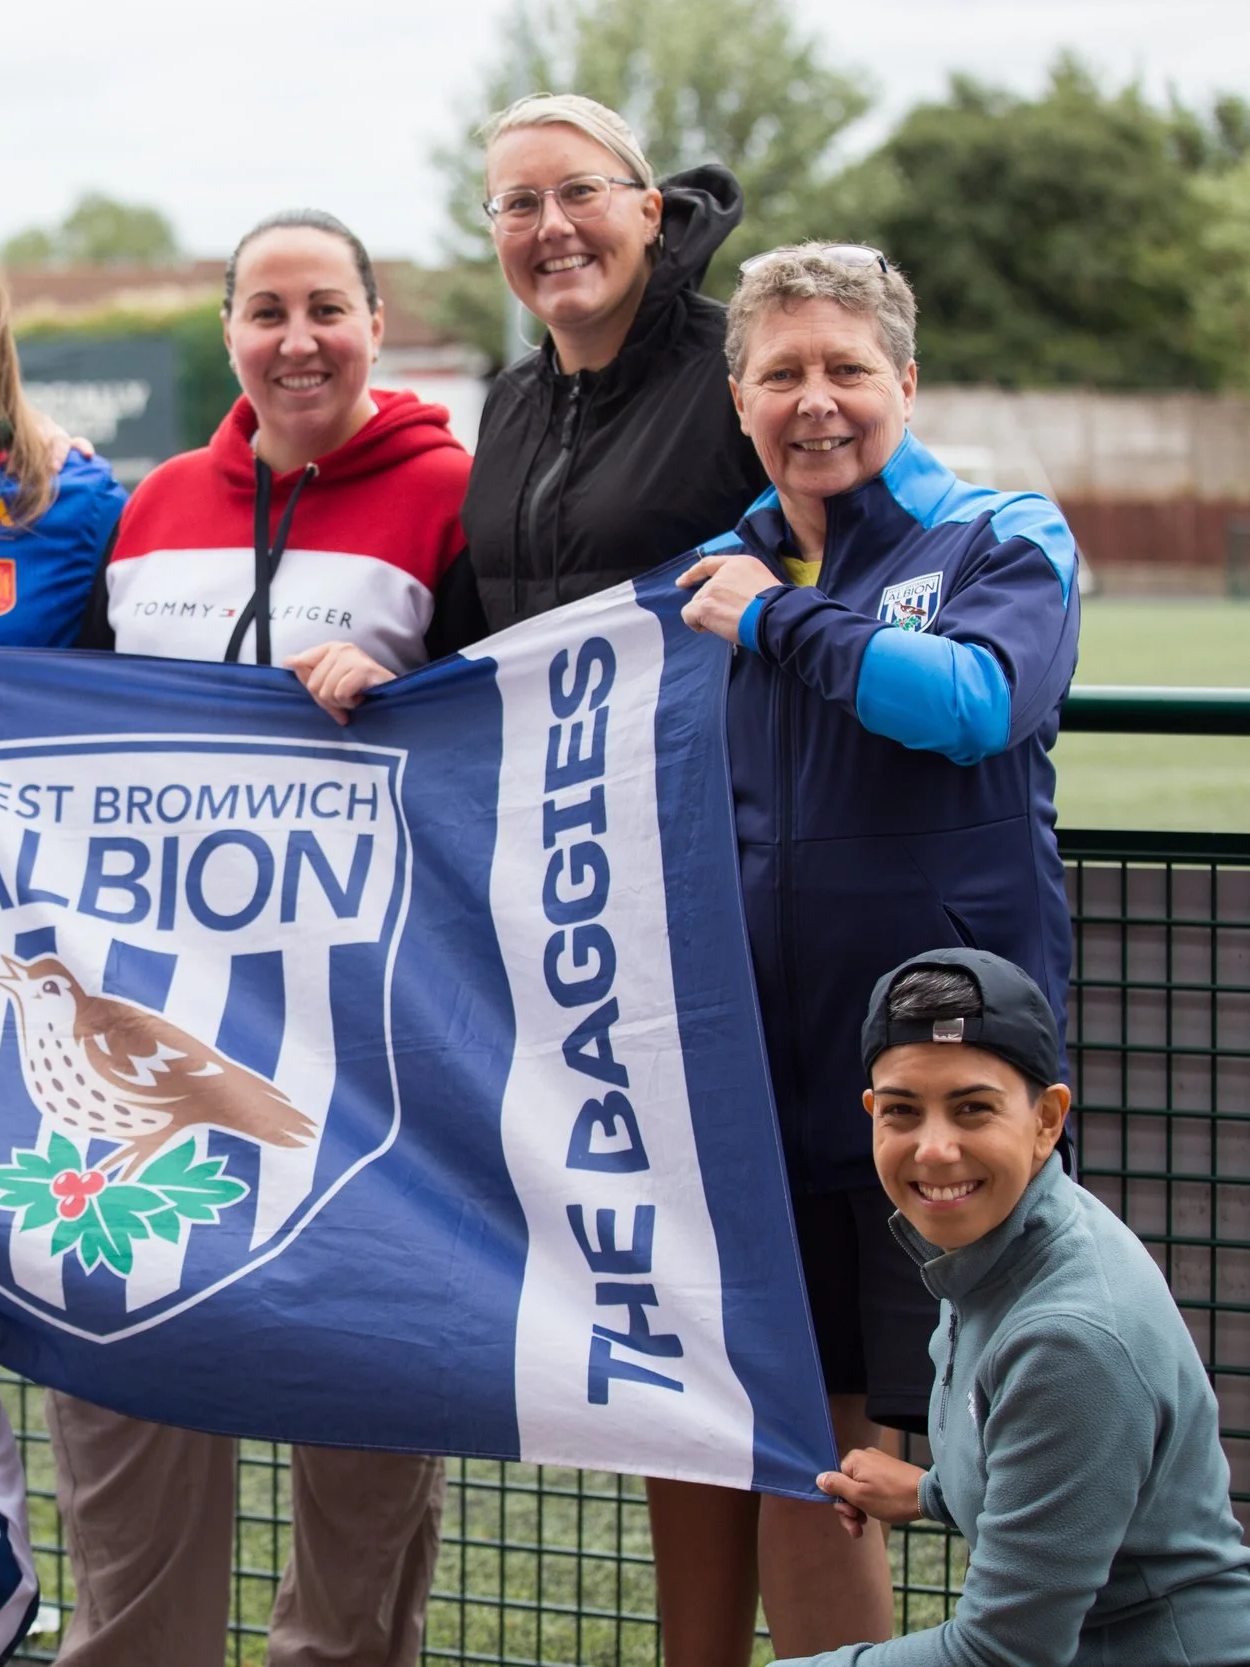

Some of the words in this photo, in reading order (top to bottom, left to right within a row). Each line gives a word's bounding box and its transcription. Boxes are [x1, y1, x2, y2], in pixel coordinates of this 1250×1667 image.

[132, 602, 214, 619] TOMMY
[888, 582, 935, 601] ALBION
[93, 782, 378, 824] BROMWICH
[543, 634, 650, 1174] BAGGIES
[565, 1203, 685, 1404] THE
